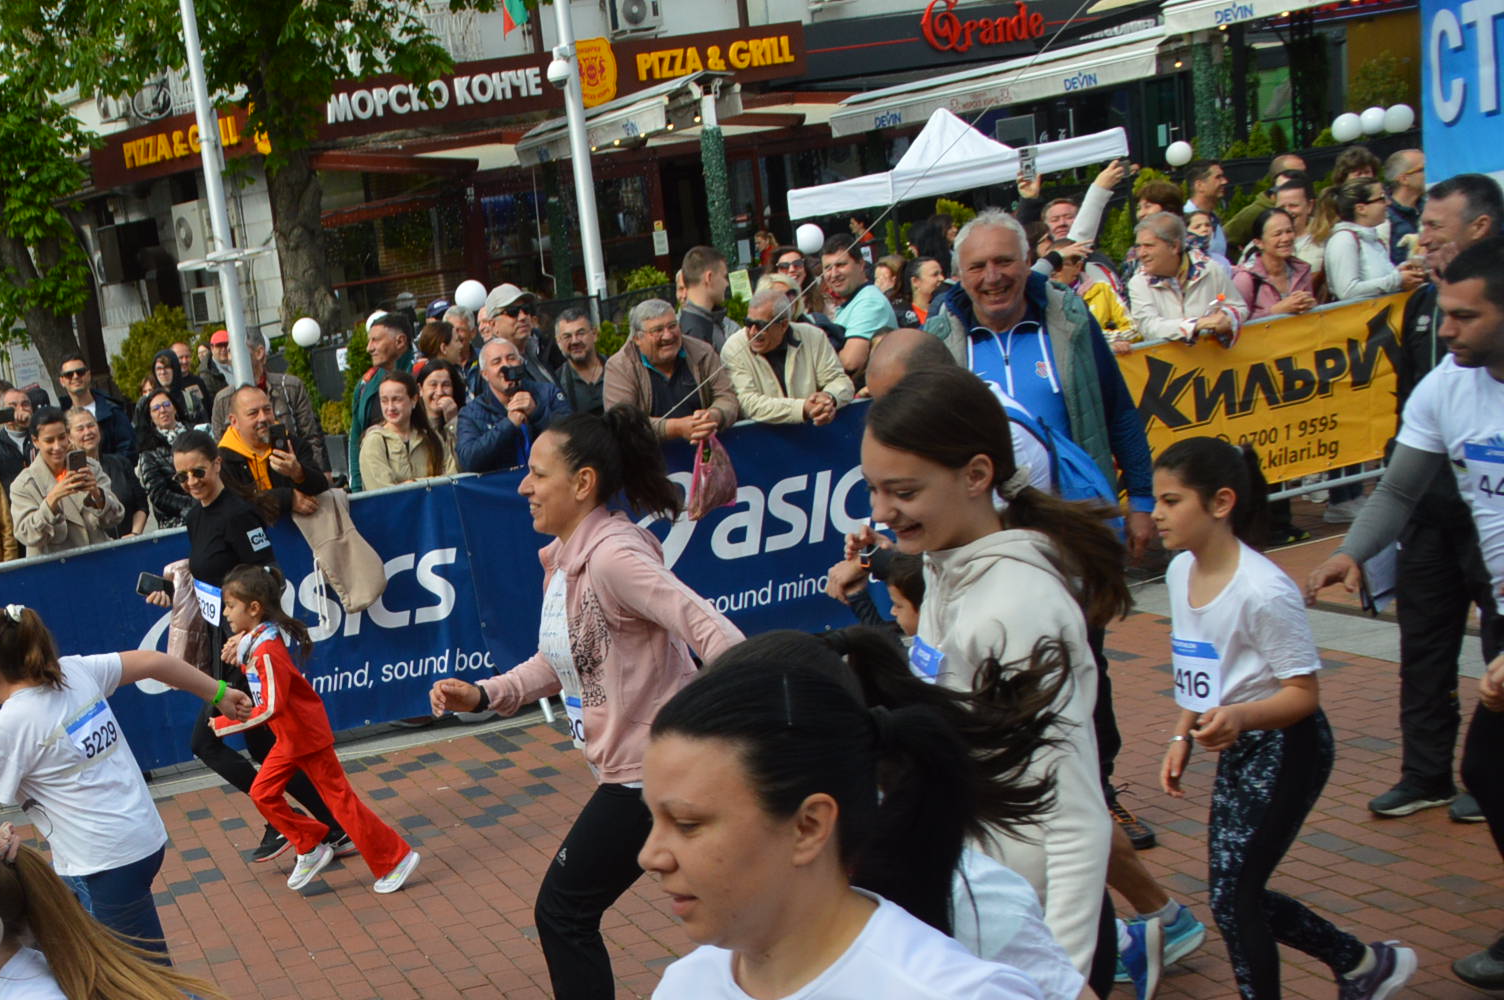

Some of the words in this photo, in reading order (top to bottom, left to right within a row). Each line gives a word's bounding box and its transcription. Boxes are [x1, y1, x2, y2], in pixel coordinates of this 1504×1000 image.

[1215, 4, 1254, 25] DEVIN
[636, 46, 704, 81] PIZZA
[707, 45, 727, 72] &
[728, 36, 795, 69] GRILL
[327, 78, 449, 124] МОРСКО
[455, 67, 543, 107] КОНЧЕ
[1064, 72, 1098, 91] DEVIN
[123, 133, 174, 168] PIZZA
[1298, 414, 1339, 438] 9595
[381, 649, 450, 683] sound
[81, 720, 118, 759] 5229
